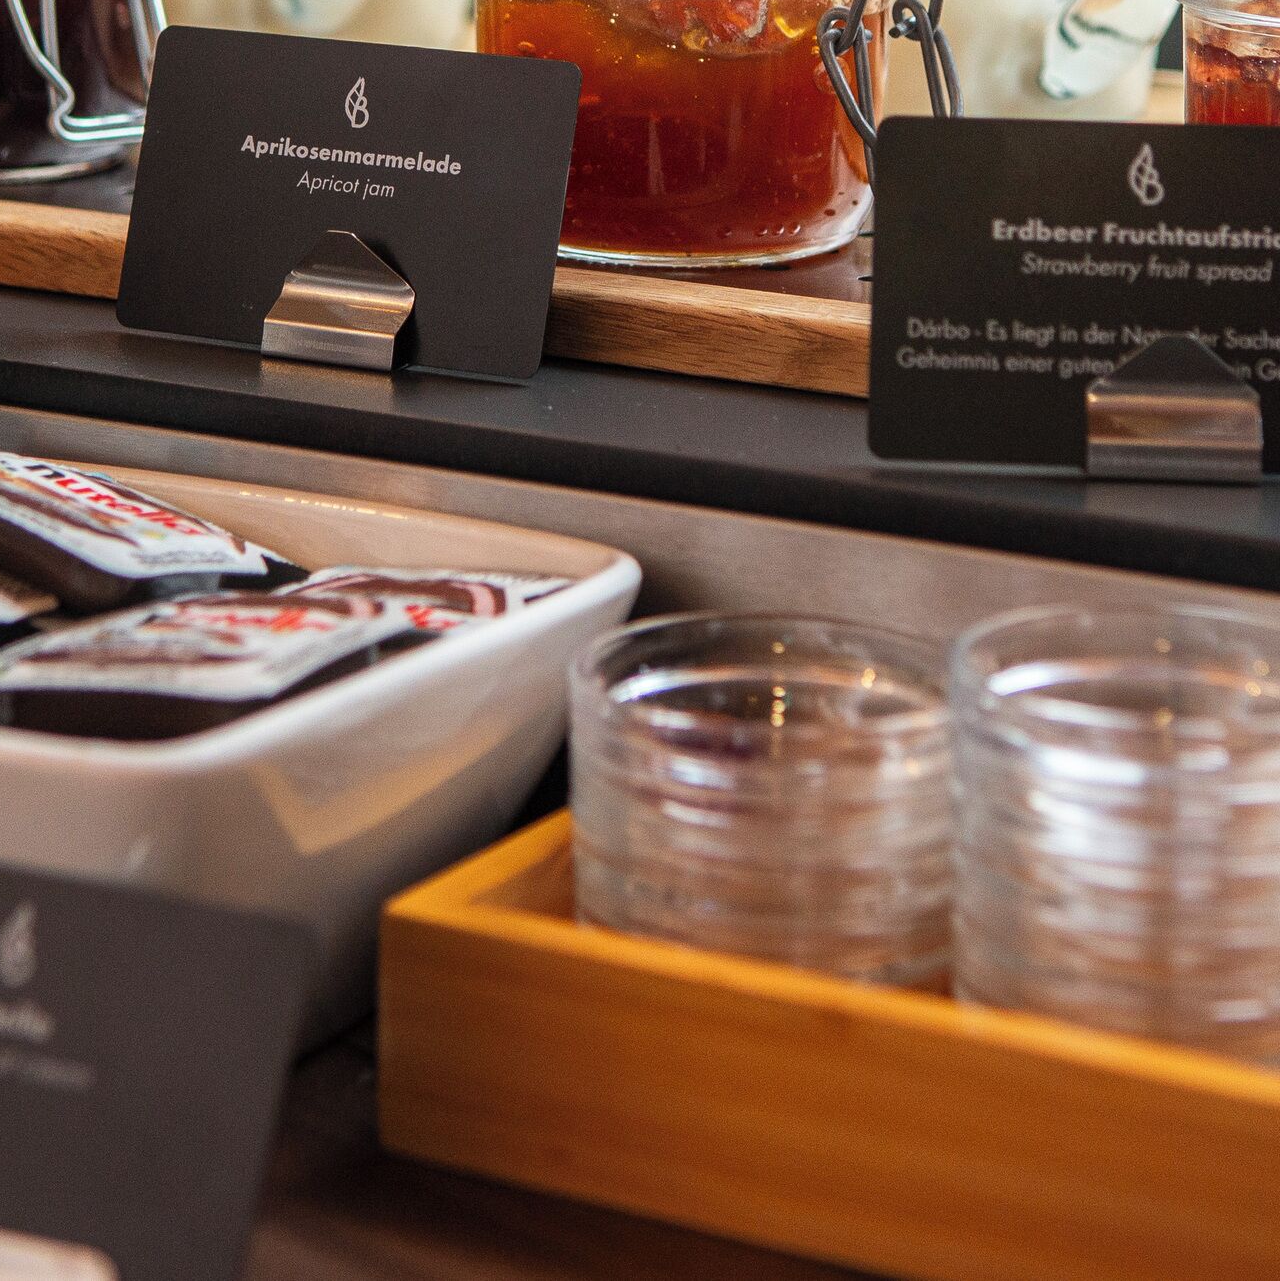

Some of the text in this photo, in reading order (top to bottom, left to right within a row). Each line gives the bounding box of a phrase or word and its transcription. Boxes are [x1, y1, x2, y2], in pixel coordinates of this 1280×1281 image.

[240, 134, 462, 176] Aprikosenmarmelade
[296, 170, 396, 201] Apricot jam
[991, 218, 1098, 246] Erdbeer
[1021, 252, 1274, 286] Strawberry fruit spread
[985, 319, 1008, 343] Es
[1011, 320, 1056, 349] liegt
[1058, 323, 1079, 344] in
[1083, 322, 1117, 345] der
[896, 347, 1000, 372] Geheimnis
[1004, 355, 1054, 373] einer
[1059, 357, 1116, 380] guten
[24, 464, 204, 536] nutella
